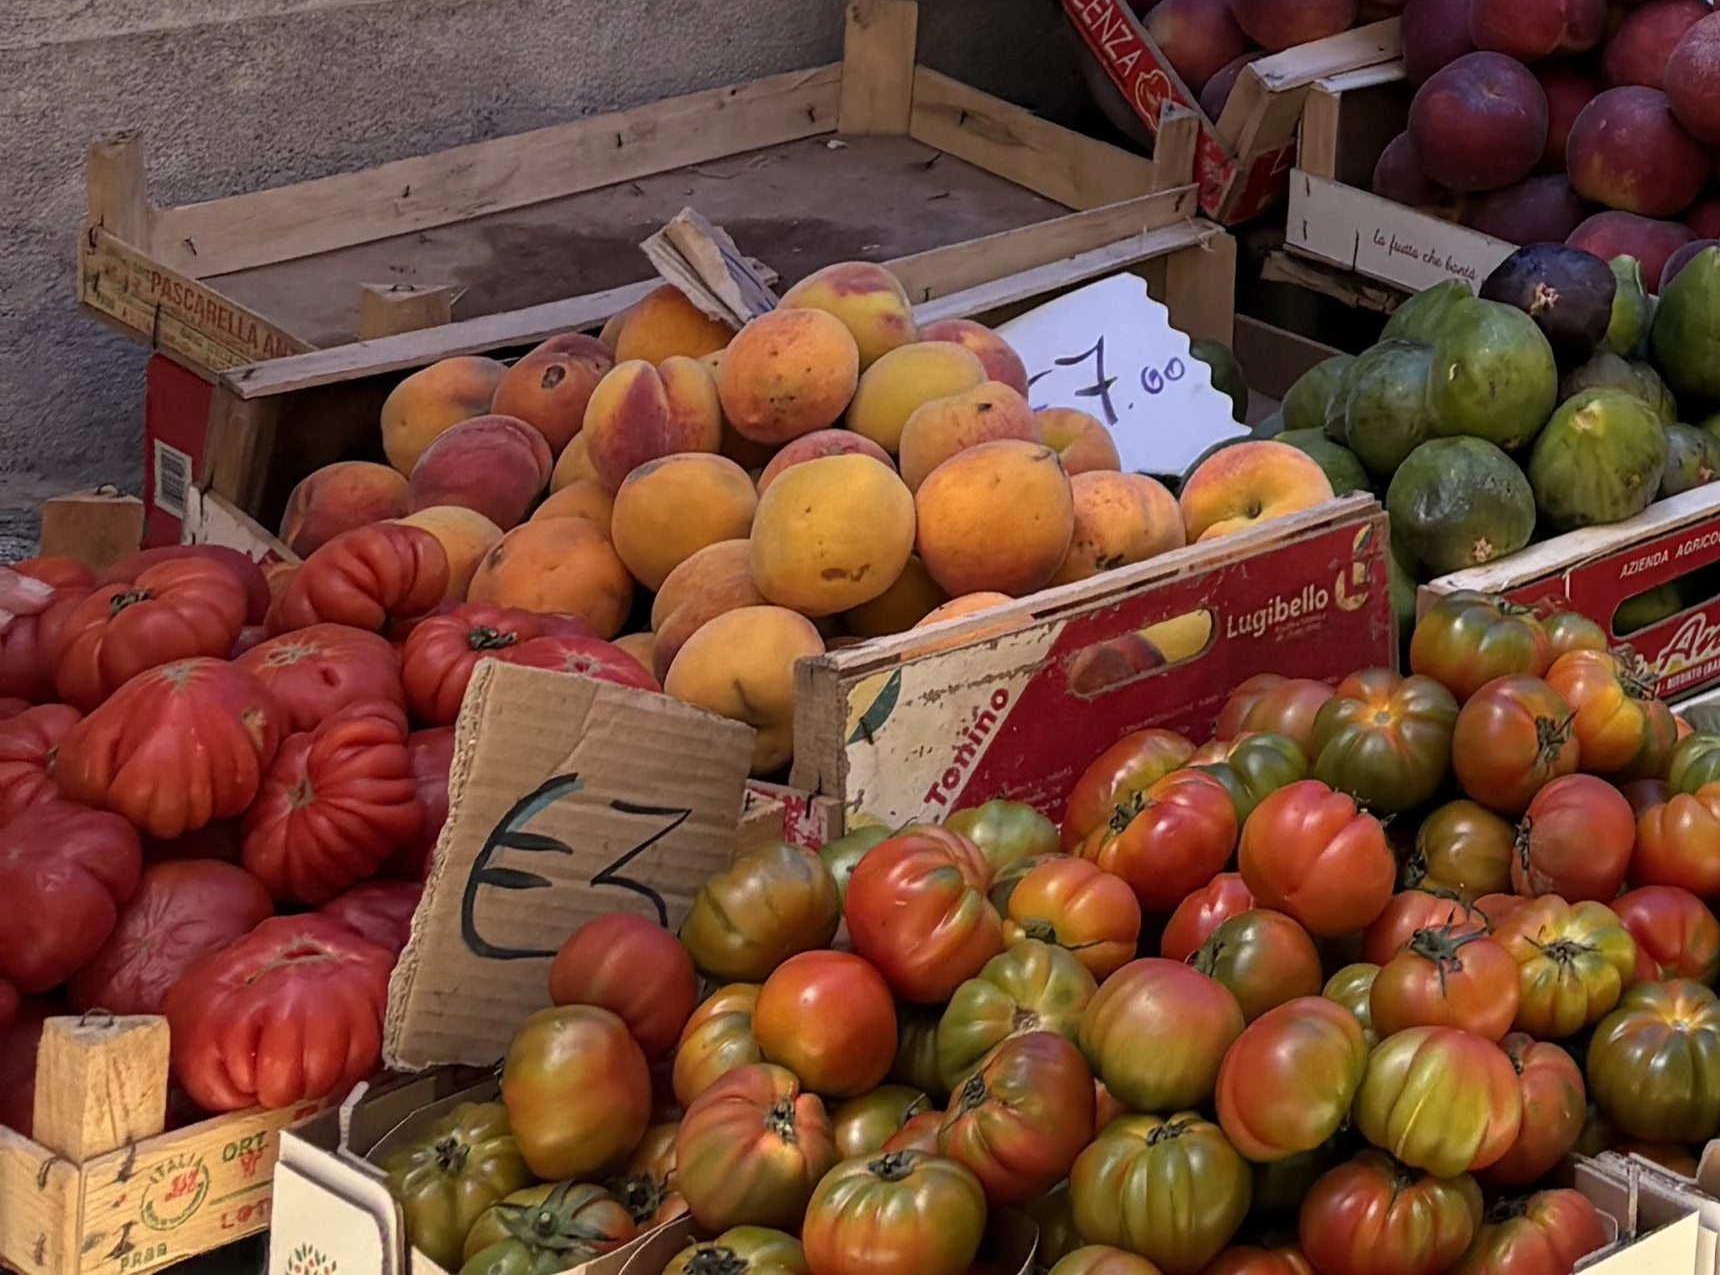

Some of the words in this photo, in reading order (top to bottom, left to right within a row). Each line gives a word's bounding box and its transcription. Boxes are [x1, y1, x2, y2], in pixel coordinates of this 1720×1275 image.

[150, 270, 259, 350] PASCARELLA
[1620, 551, 1669, 580] AZIENDA
[1227, 583, 1330, 640] Lugibello
[924, 687, 1010, 808] Tonino
